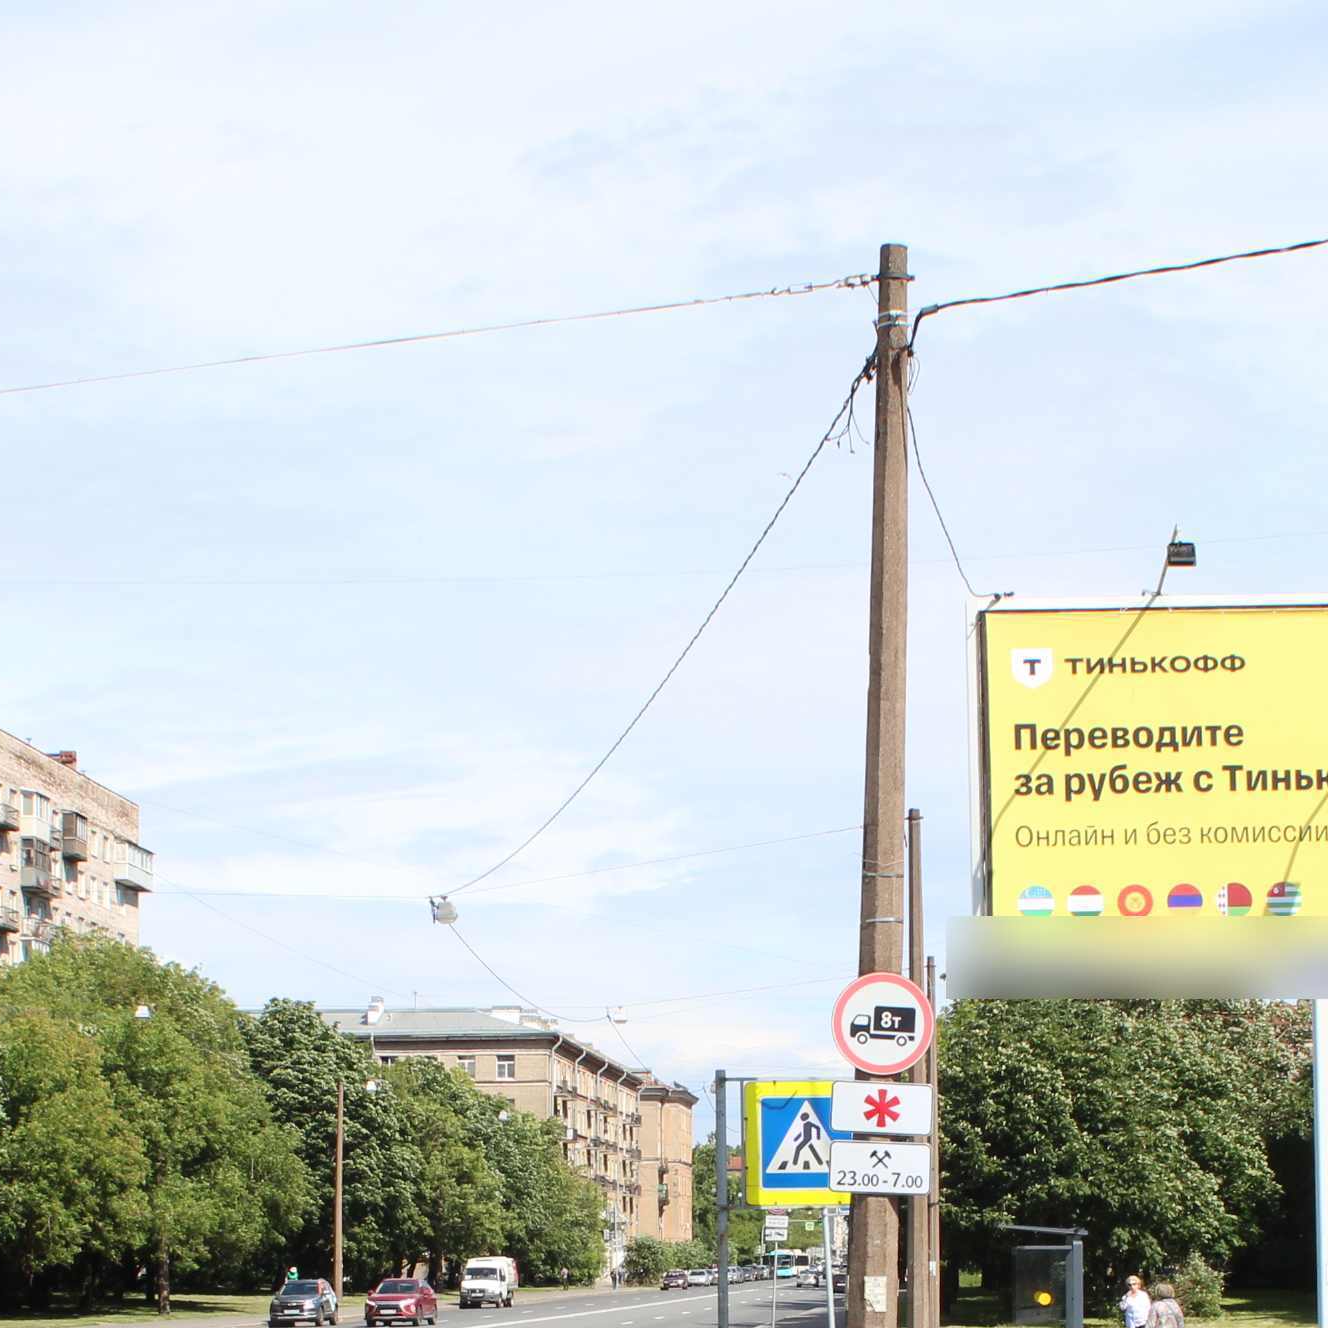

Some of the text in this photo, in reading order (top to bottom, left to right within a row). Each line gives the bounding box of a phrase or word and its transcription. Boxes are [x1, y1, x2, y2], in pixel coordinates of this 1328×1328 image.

[1064, 653, 1247, 675] ТИНЬКОФФ
[1013, 722, 1245, 756] Переводите
[1013, 772, 1055, 796] за
[1063, 763, 1184, 802] рубеж
[1014, 821, 1116, 848] Онлайн
[1123, 826, 1138, 846] и
[1146, 820, 1192, 846] без
